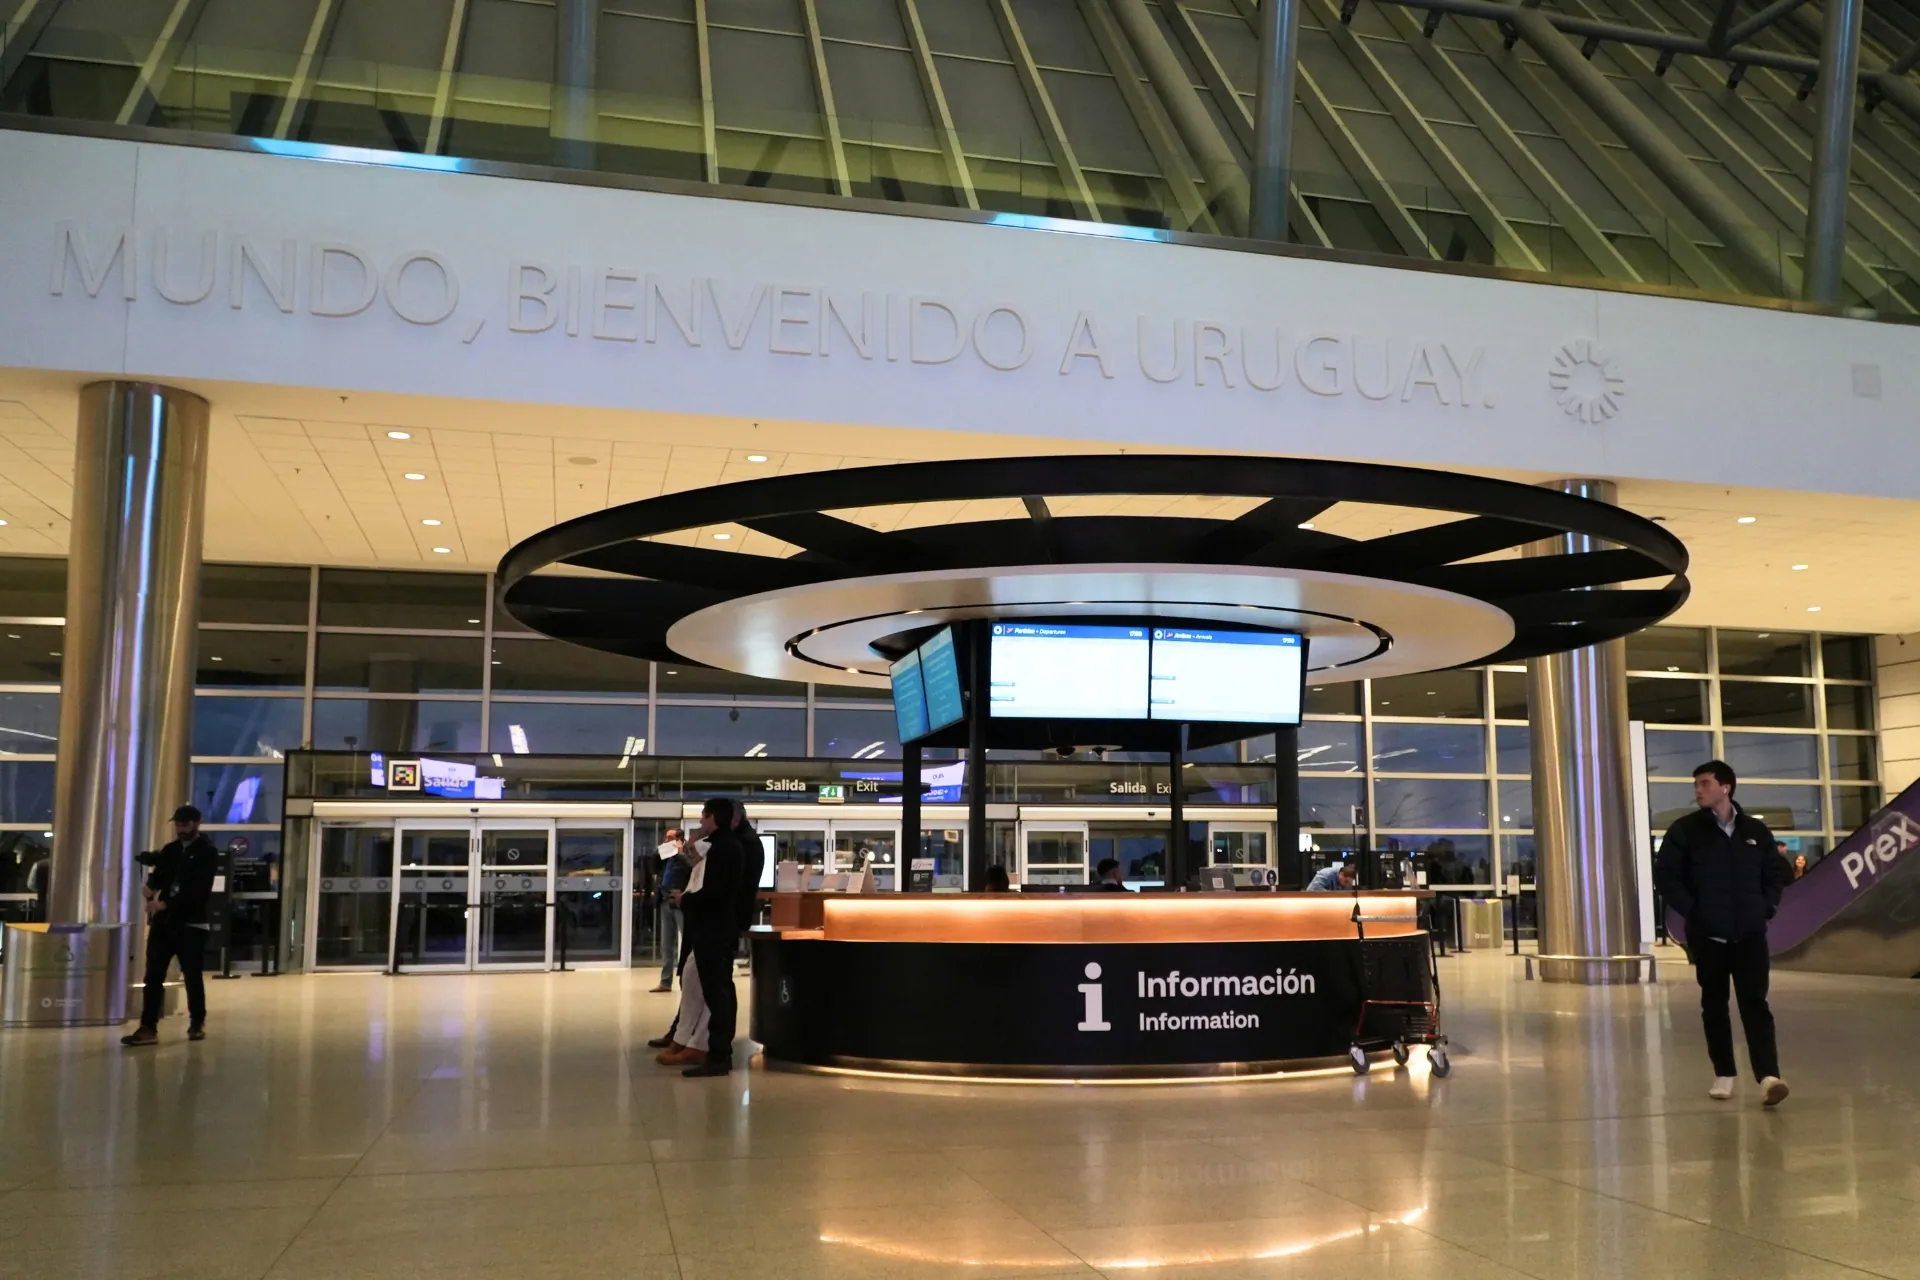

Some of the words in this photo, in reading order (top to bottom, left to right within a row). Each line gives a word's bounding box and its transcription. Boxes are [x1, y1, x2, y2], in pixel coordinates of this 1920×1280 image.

[49, 219, 486, 345] MUNDO,
[507, 260, 1033, 372] BIENVENIDO
[1058, 310, 1114, 381] A
[1136, 314, 1496, 411] URUGUAY.
[765, 778, 806, 792] Salida
[857, 780, 879, 792] Exit
[1110, 782, 1146, 793] Salida
[1156, 783, 1171, 794] Exi
[1840, 818, 1919, 890] Prex
[1138, 967, 1316, 998] Información
[1138, 1010, 1260, 1031] Information
